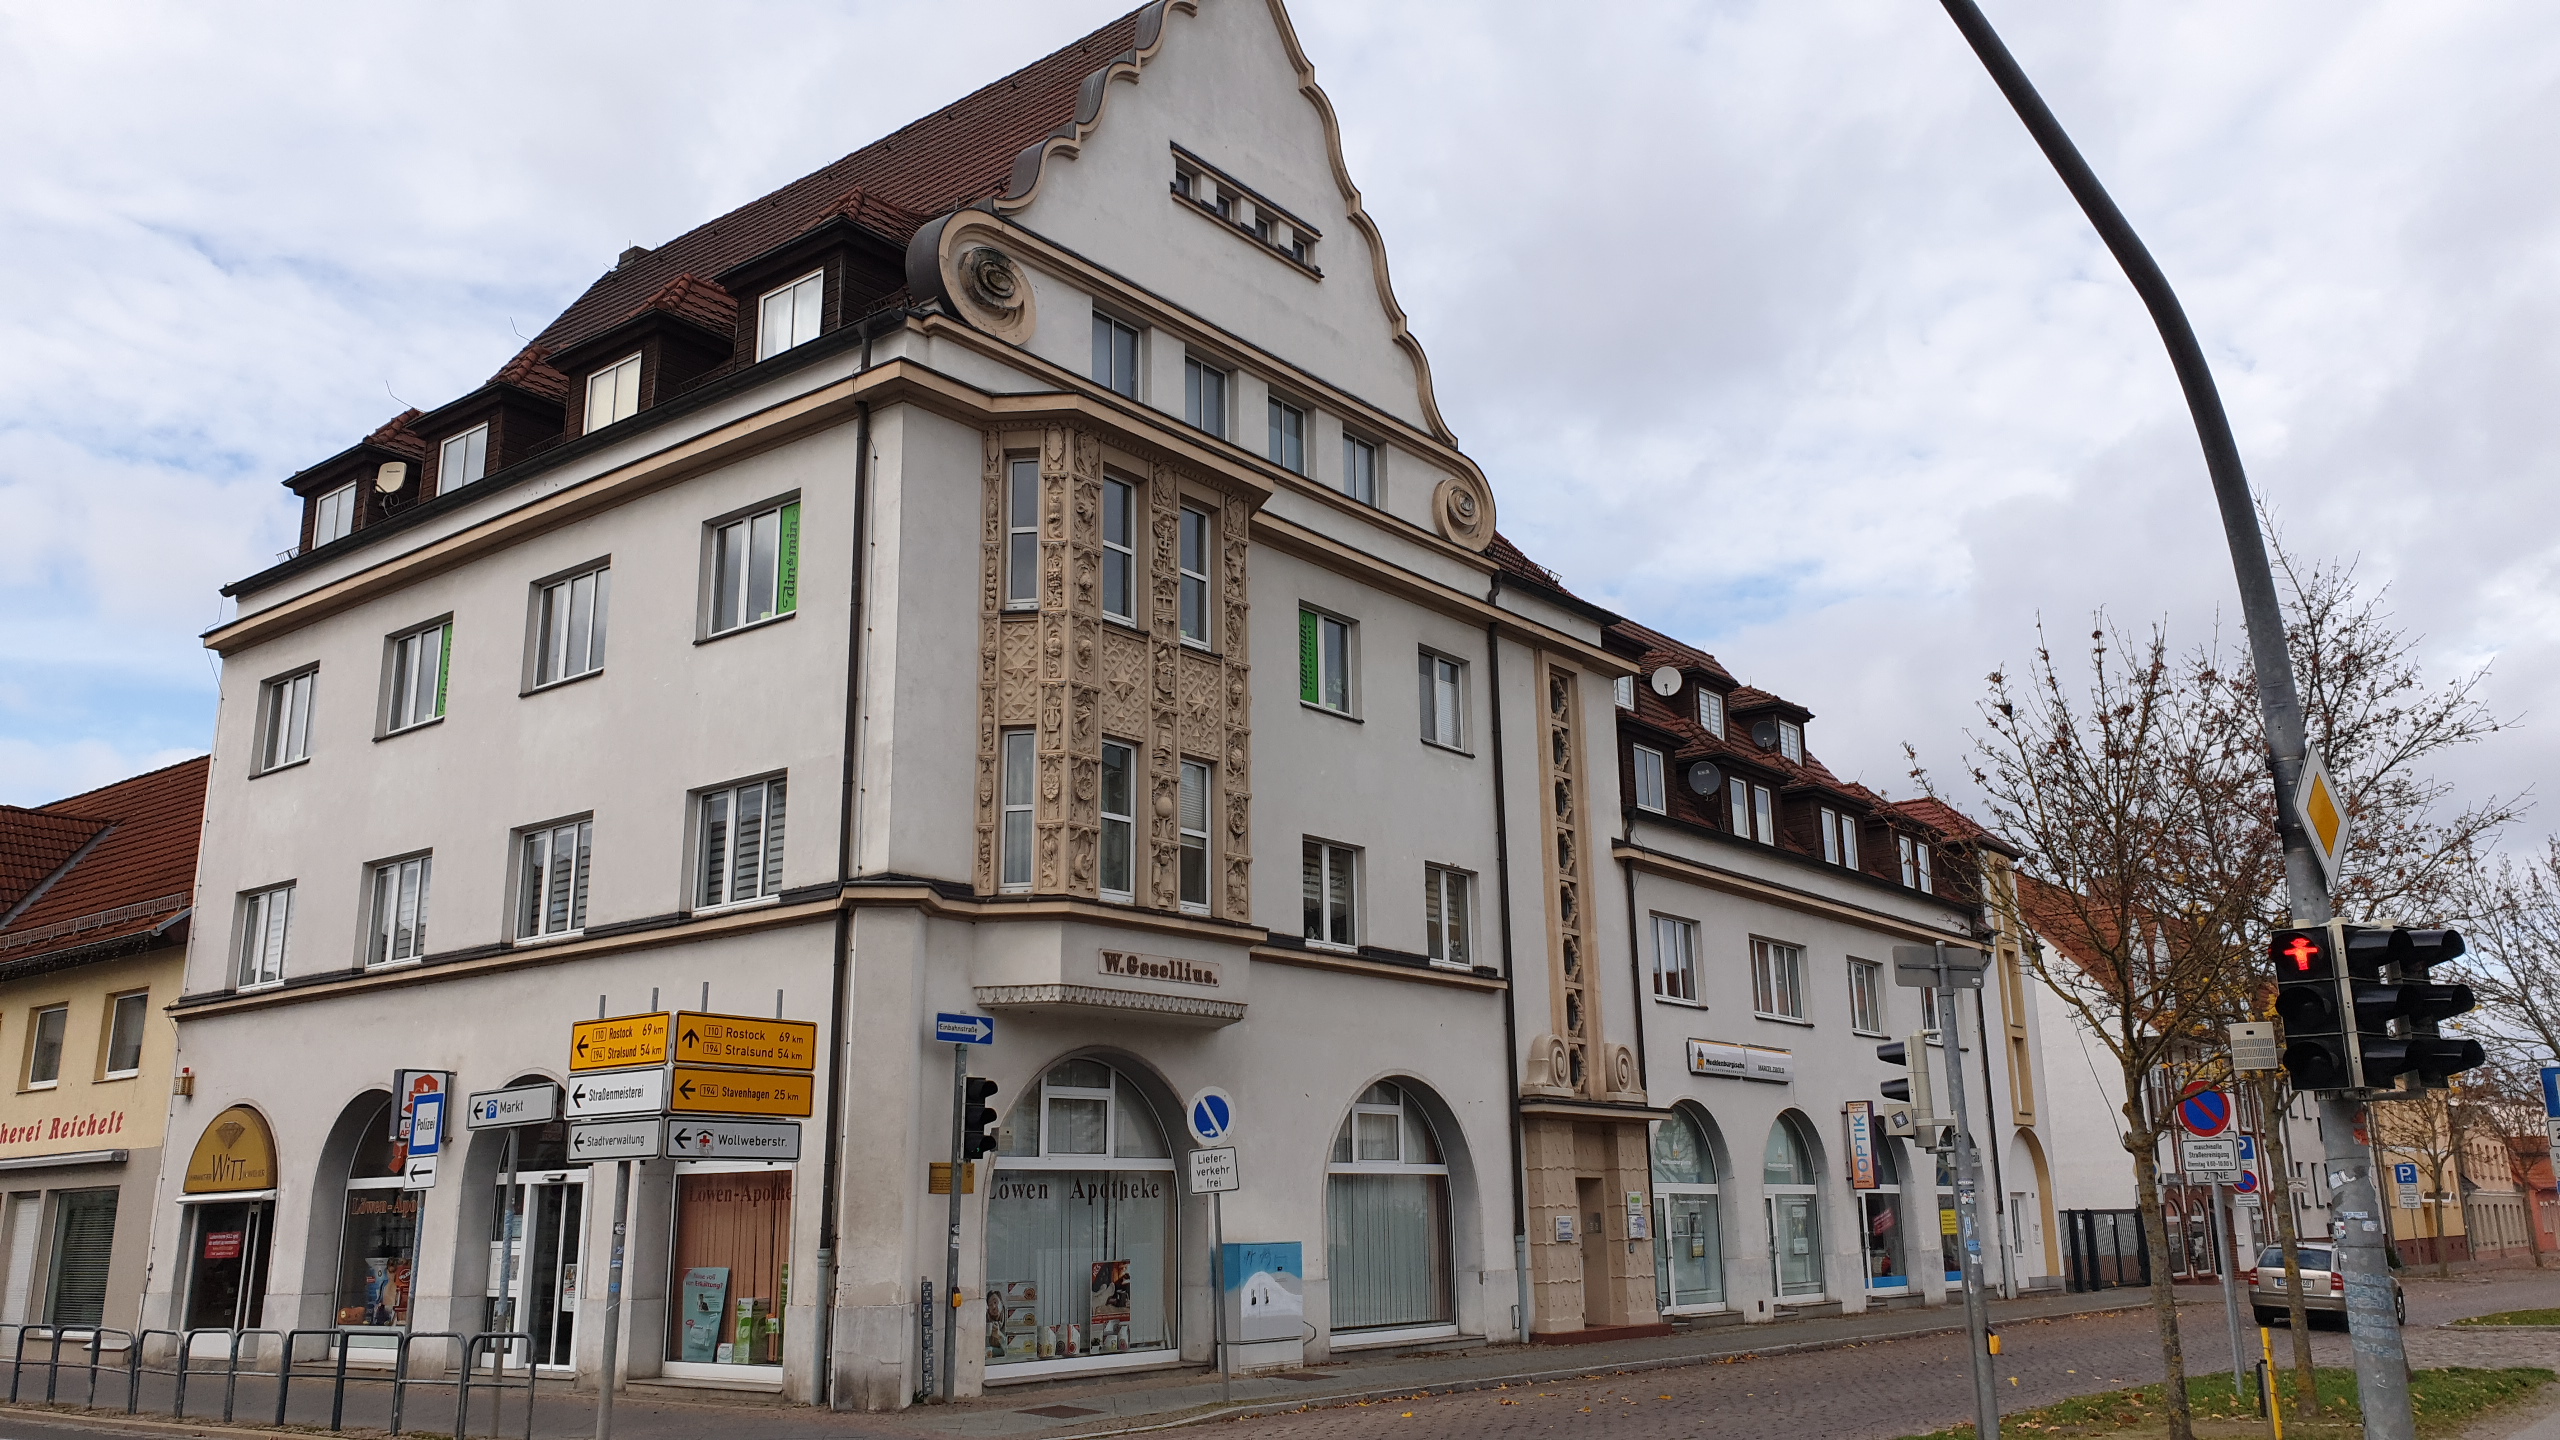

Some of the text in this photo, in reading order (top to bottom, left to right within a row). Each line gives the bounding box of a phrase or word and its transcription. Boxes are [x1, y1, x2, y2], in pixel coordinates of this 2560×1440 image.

[594, 1023, 664, 1040] 110 Rostock 69 km
[707, 1027, 804, 1044] 110 Rostock 69 km
[939, 1023, 978, 1034] Einbahnstraße
[592, 1044, 662, 1060] 194 Stralsund 54 km
[706, 1044, 803, 1061] 194 Stralsund 54 km
[588, 1085, 645, 1102] Straßenmeisterei
[702, 1086, 799, 1102] 194 Stavenhagen 25 km
[499, 1100, 524, 1114] Markt
[48, 1110, 124, 1140] Reichelt
[416, 1117, 436, 1132] Polizei
[587, 1134, 645, 1147] Stadtverwaltung
[718, 1134, 788, 1147] Wollweberstr.
[1853, 1114, 1868, 1172] OPTIK
[1197, 1153, 1227, 1165] Liefer-
[1196, 1165, 1230, 1177] verkehr
[2204, 1172, 2230, 1180] ZNE
[2398, 1166, 2411, 1182] P
[1206, 1177, 1222, 1188] frei
[1070, 1177, 1160, 1206] Apotheke
